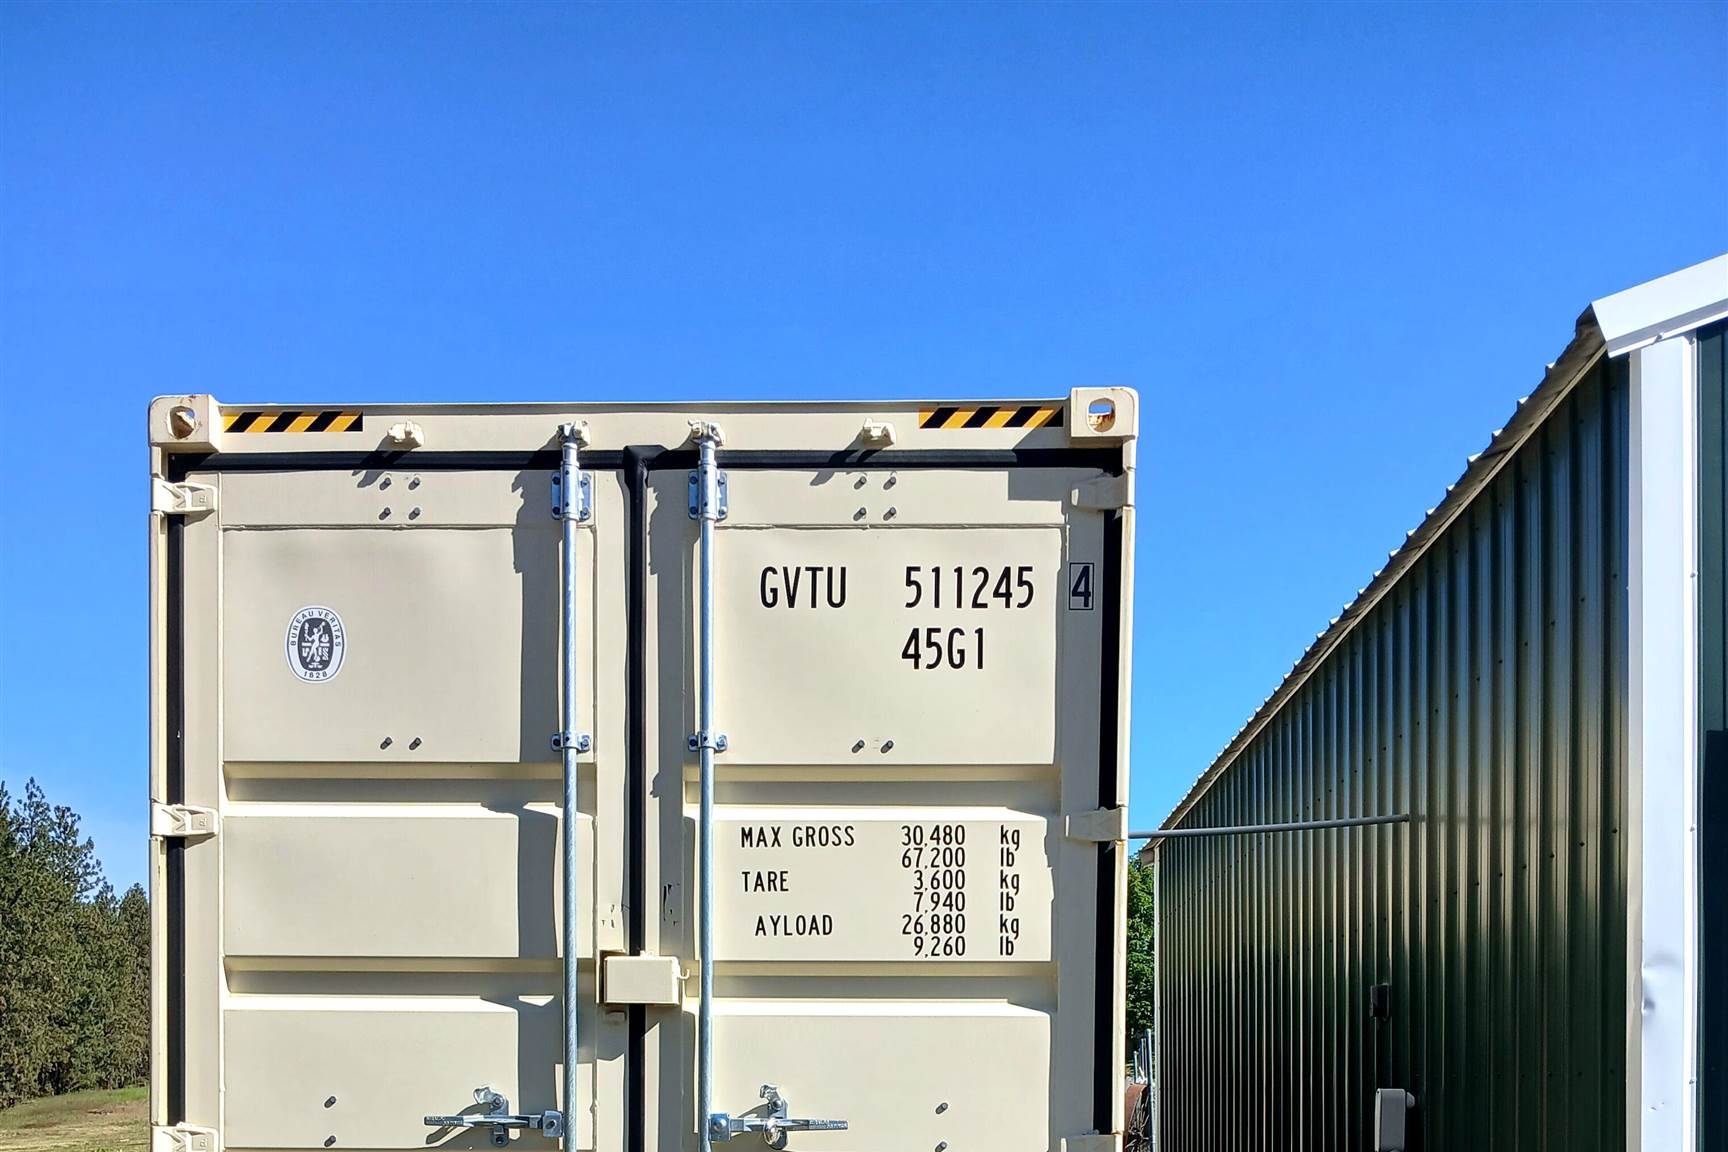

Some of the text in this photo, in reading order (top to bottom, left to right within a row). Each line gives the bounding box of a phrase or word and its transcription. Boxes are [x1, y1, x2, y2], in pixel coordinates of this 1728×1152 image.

[760, 565, 1092, 609] GVTU 511245 4
[290, 611, 341, 647] BUREAU VERITAS
[901, 627, 984, 670] 45G1
[741, 824, 1020, 852] MAX GROSS 30,480 kg
[901, 846, 1015, 870] 67,200 lb
[741, 869, 1020, 896] TARE 3,600 kg
[913, 891, 1015, 915] 7,940 lb
[754, 913, 1020, 940] AYLOAD 26,880 kg
[913, 935, 1015, 958] 9,260 lb
